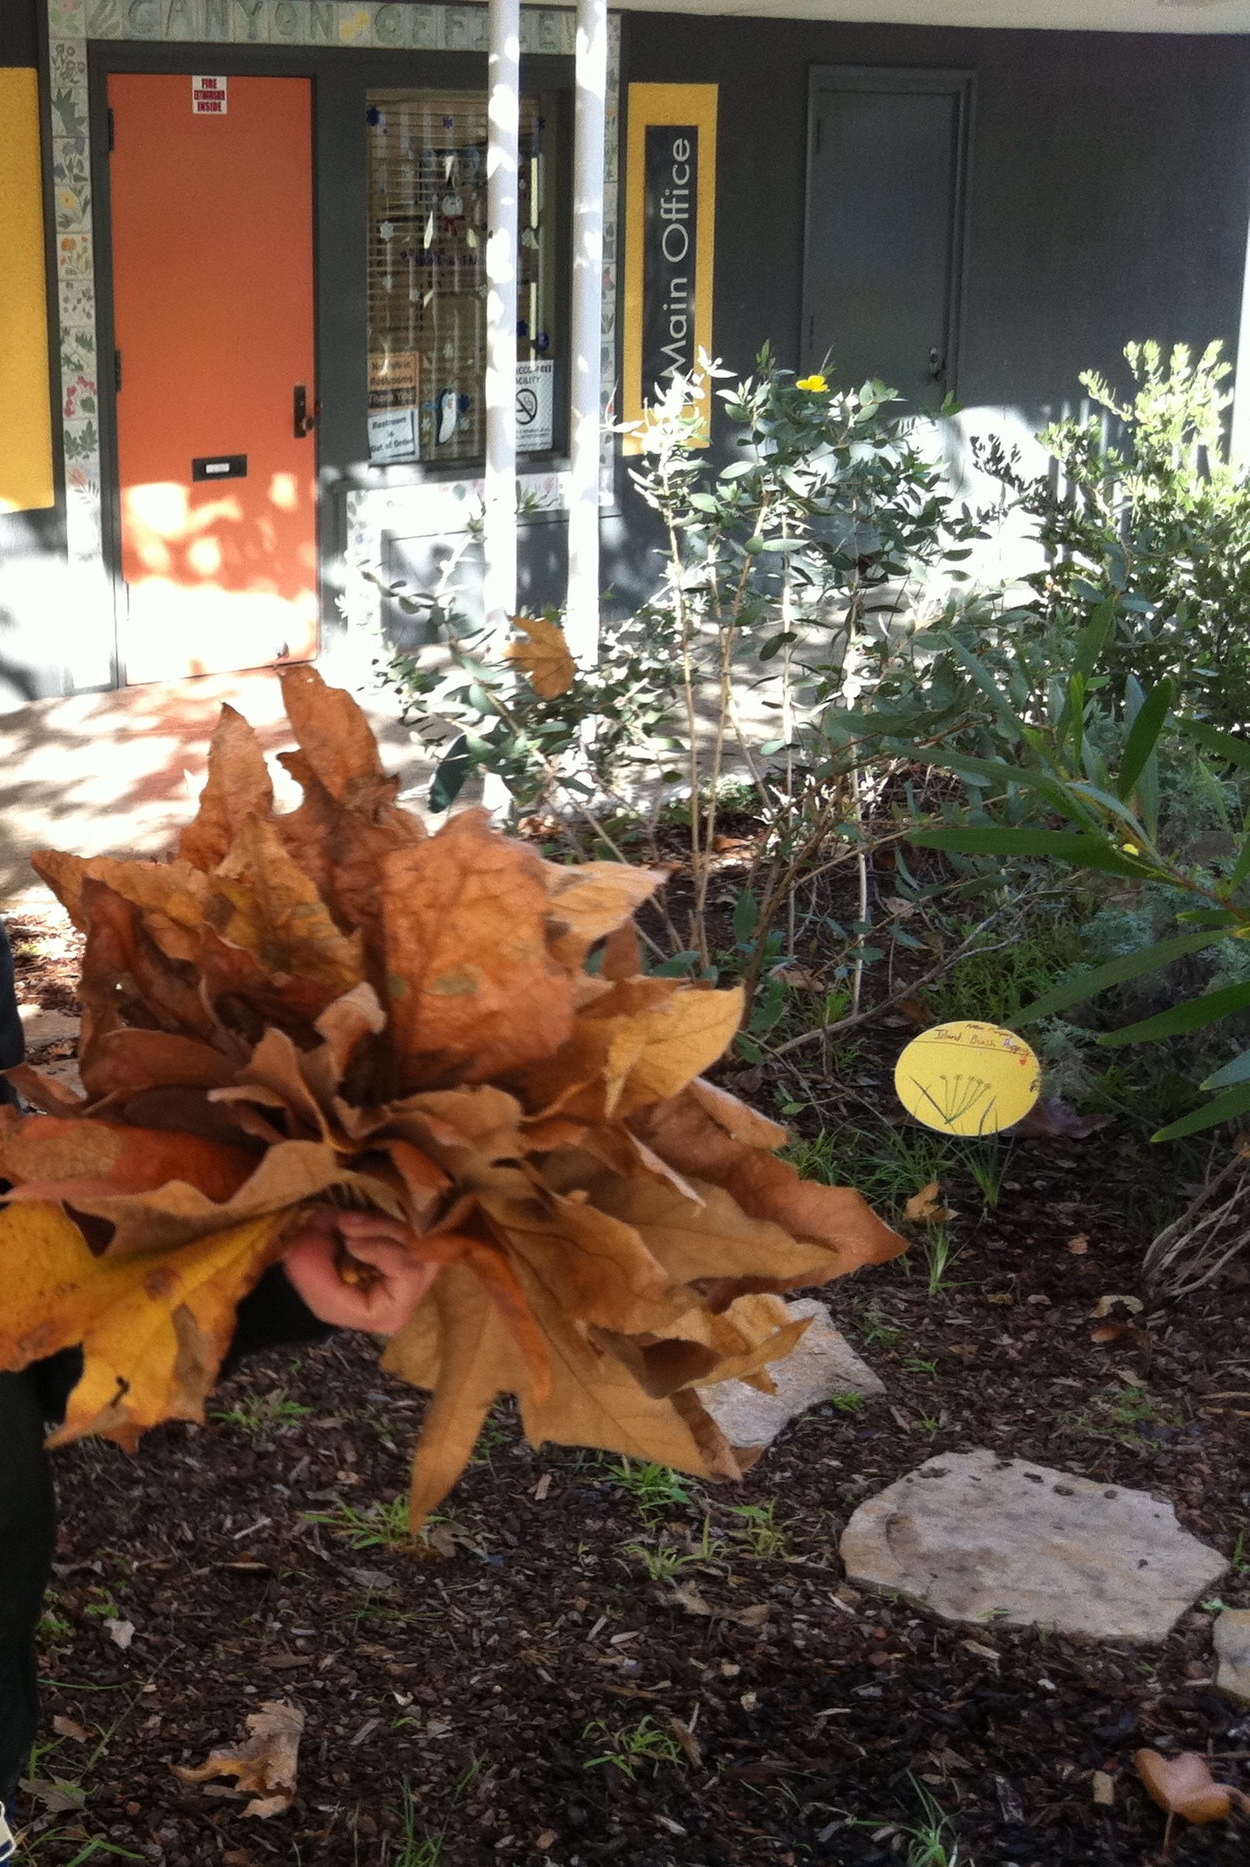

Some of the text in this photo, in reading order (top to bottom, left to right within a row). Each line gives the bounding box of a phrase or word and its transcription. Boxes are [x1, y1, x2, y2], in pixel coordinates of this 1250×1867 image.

[127, 0, 557, 50] CANYON OFFIE
[201, 78, 218, 89] FIRE
[197, 102, 222, 112] INSIDE
[659, 137, 691, 379] Main Office
